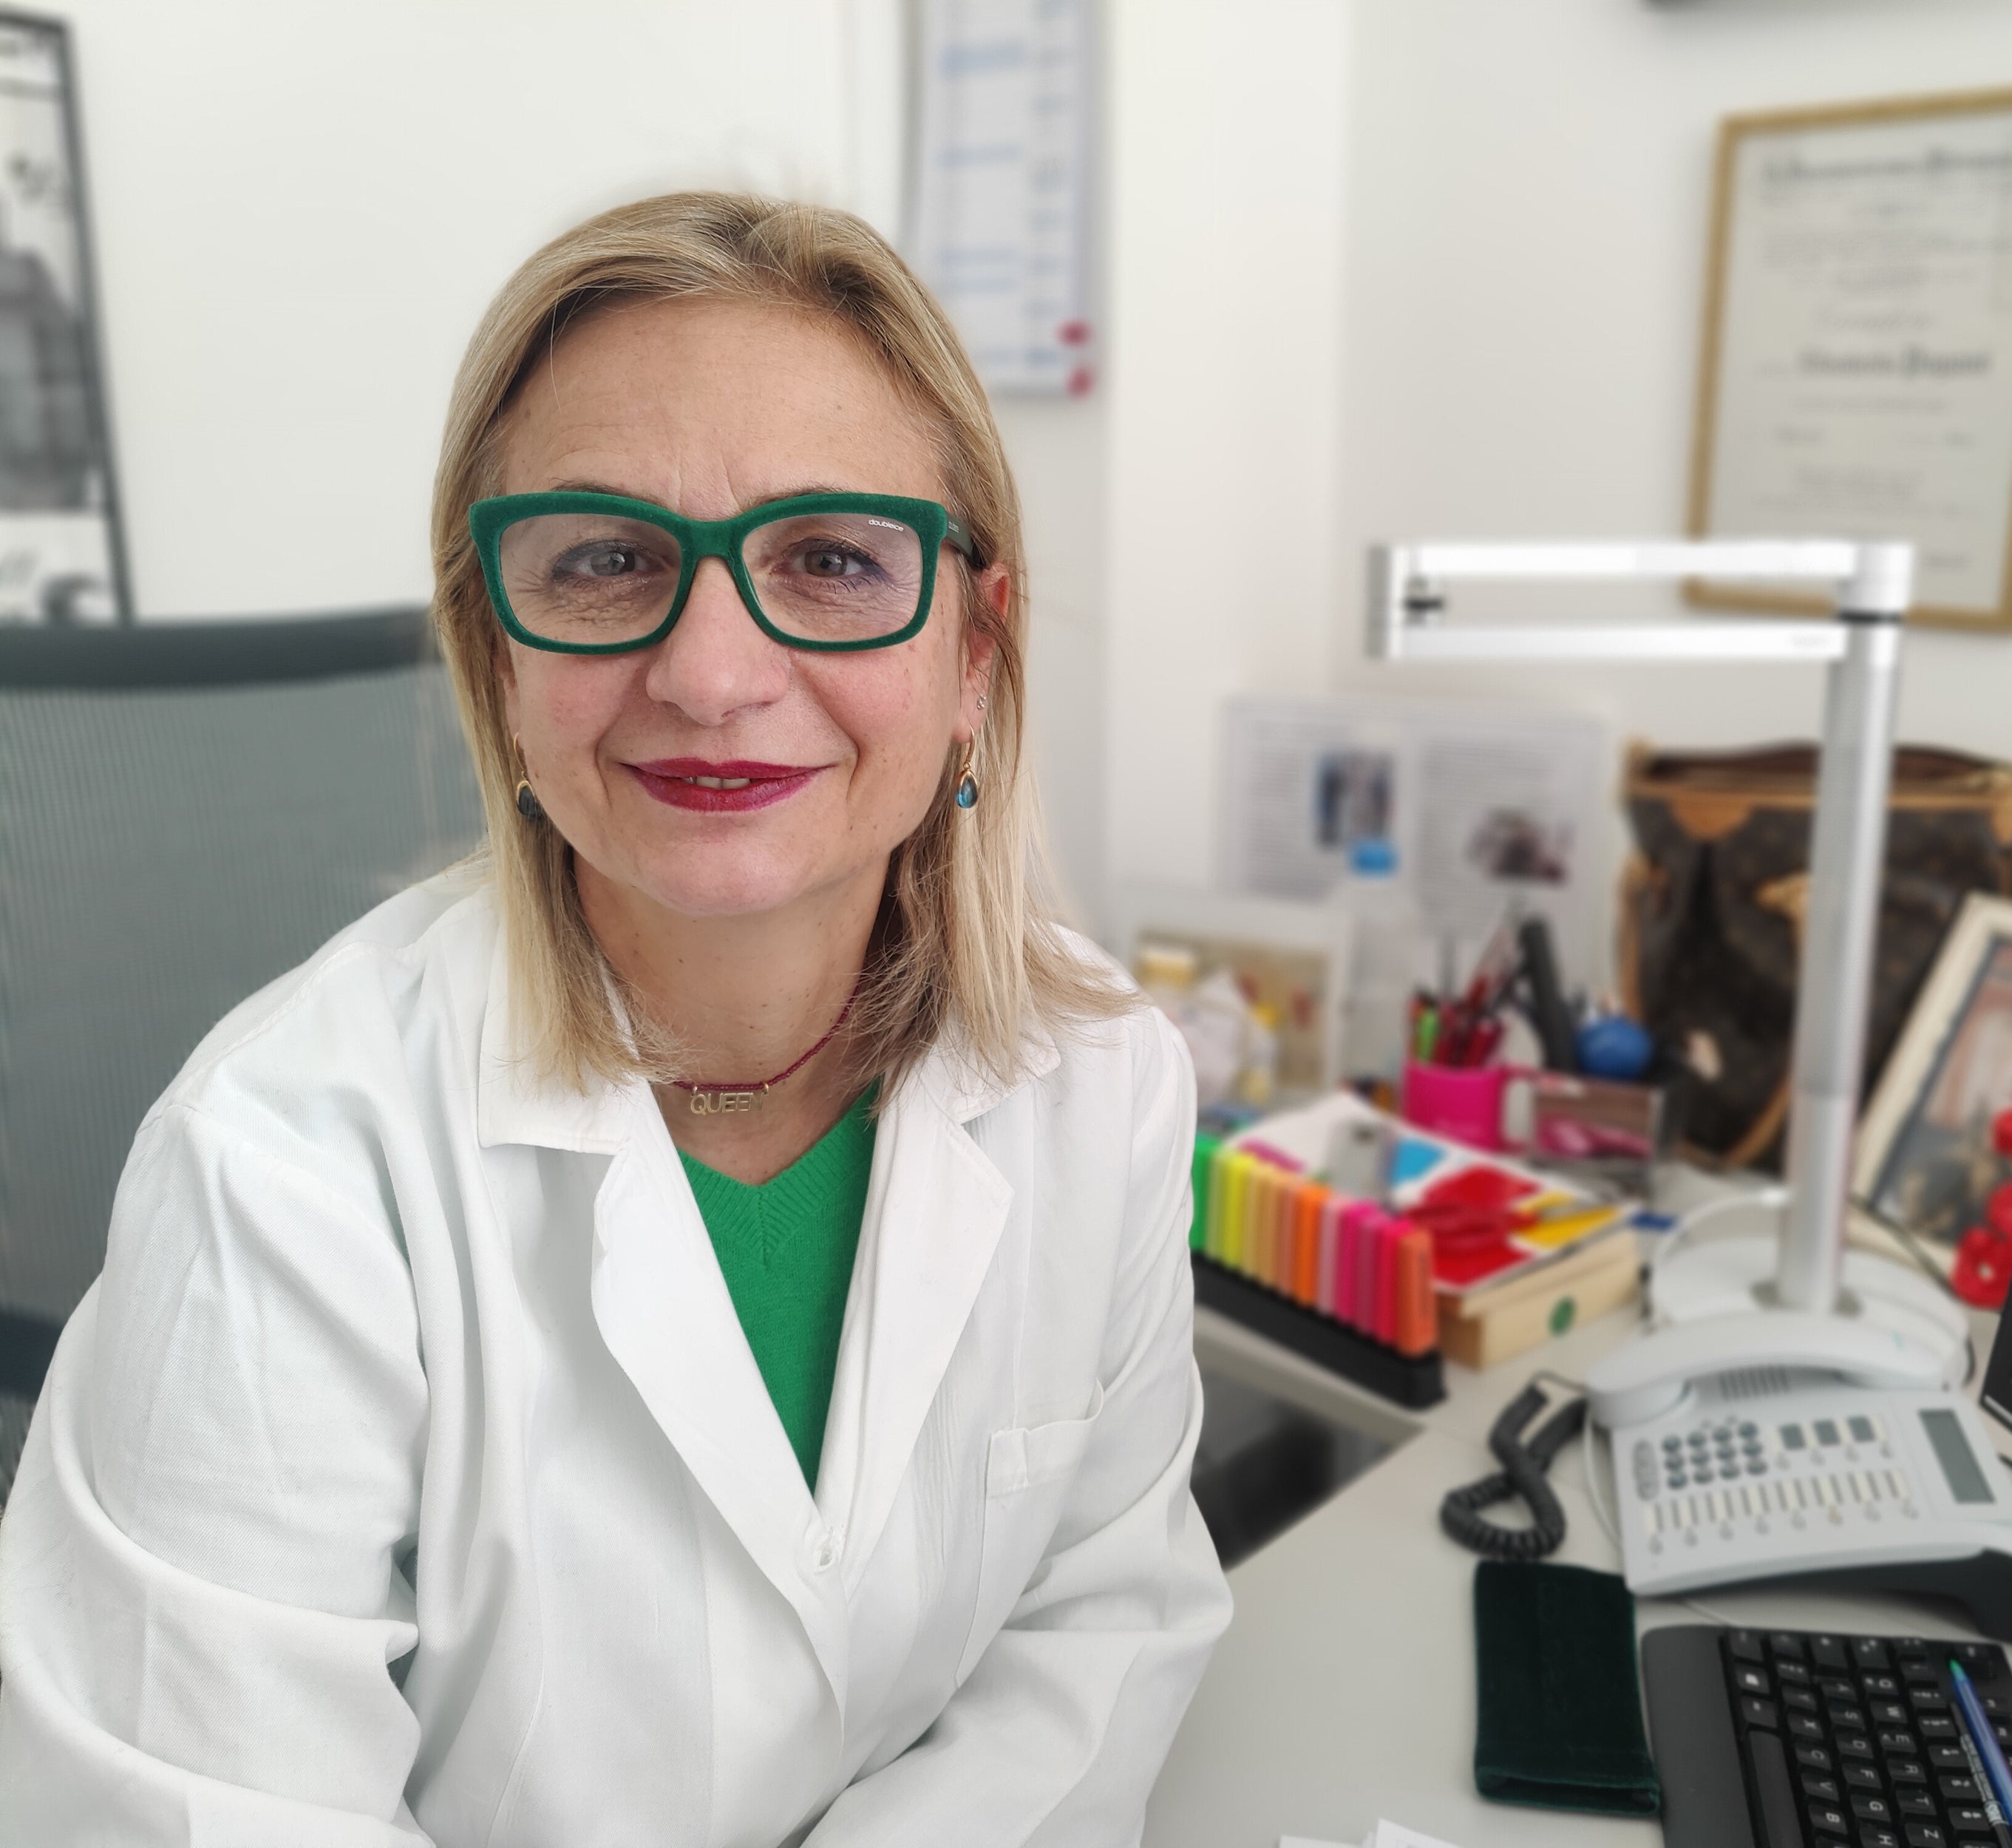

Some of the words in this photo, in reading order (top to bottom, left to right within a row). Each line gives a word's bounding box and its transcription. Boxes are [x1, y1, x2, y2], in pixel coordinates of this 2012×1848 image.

[690, 1093, 764, 1116] QUEEN
[1845, 1711, 1859, 1720] S
[1803, 1719, 1817, 1730] X
[1852, 1739, 1867, 1750] D
[1895, 1734, 1911, 1745] E
[1811, 1750, 1825, 1761] C
[1860, 1769, 1875, 1779] F
[1819, 1781, 1833, 1791] V
[1869, 1801, 1883, 1811] G
[1915, 1796, 1929, 1807] T
[1825, 1812, 1841, 1824] B
[1923, 1828, 1940, 1839] Z
[1878, 1834, 1893, 1847] H
